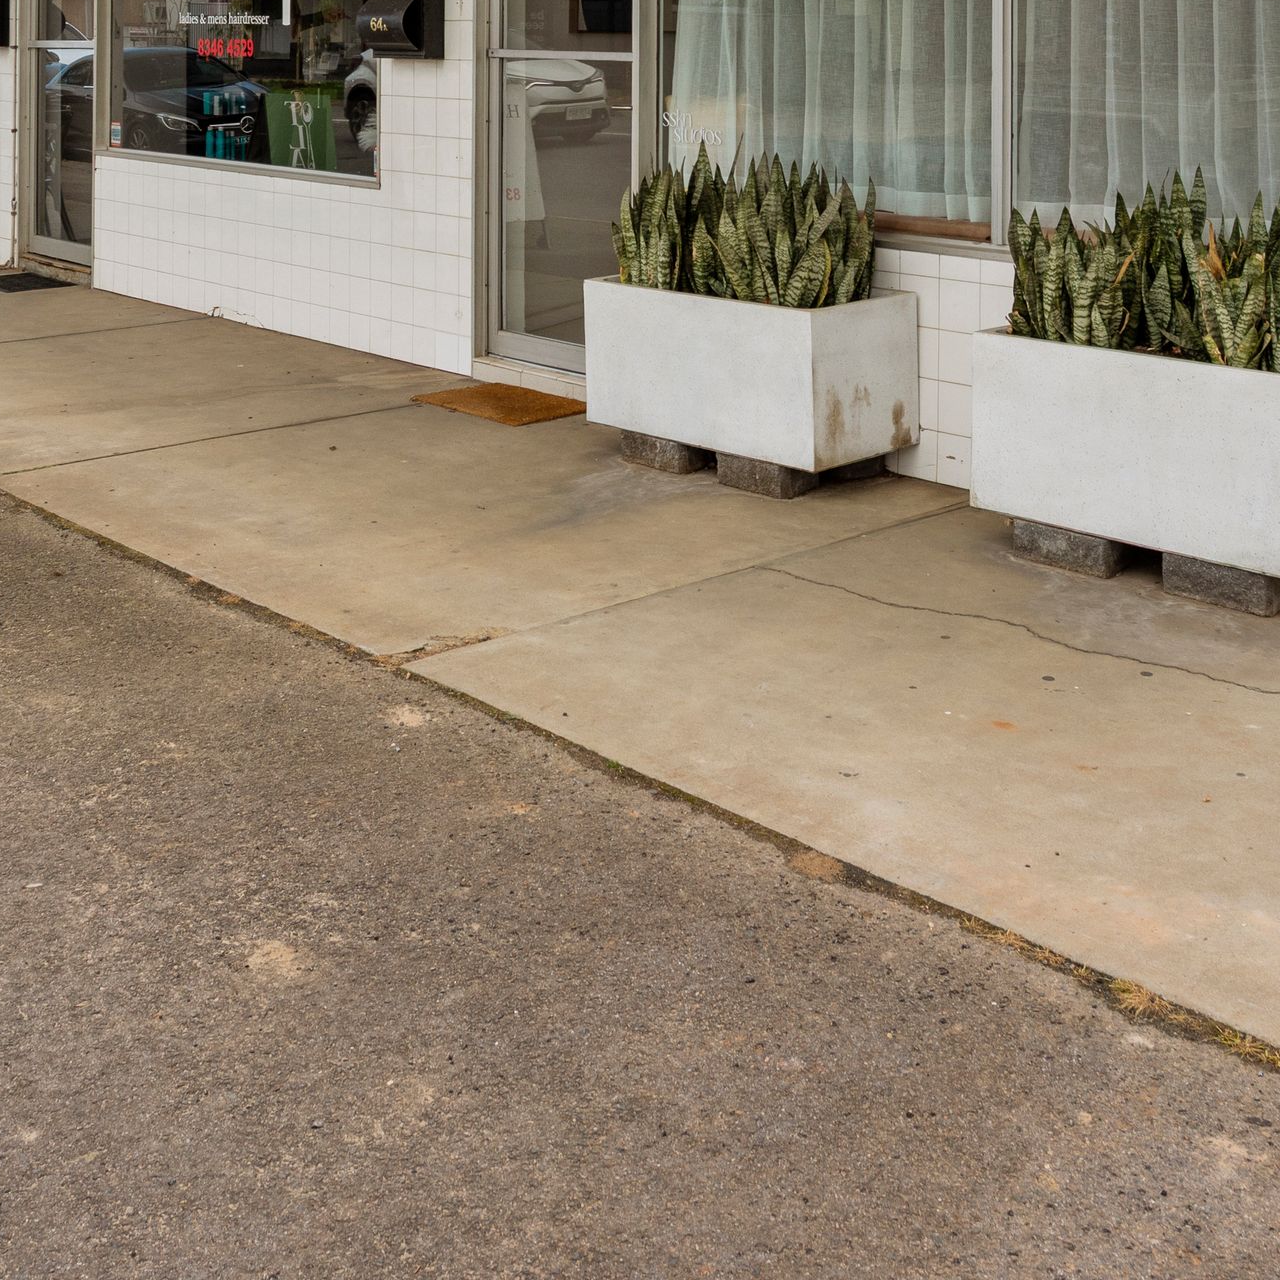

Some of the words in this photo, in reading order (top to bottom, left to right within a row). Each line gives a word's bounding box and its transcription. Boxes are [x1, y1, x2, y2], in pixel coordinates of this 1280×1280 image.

[179, 12, 199, 24] ladies
[199, 13, 206, 24] &
[207, 14, 227, 25] mens
[228, 12, 270, 25] hairdresser
[198, 38, 224, 57] 8346
[227, 38, 255, 57] 4529
[673, 127, 722, 146] studios
